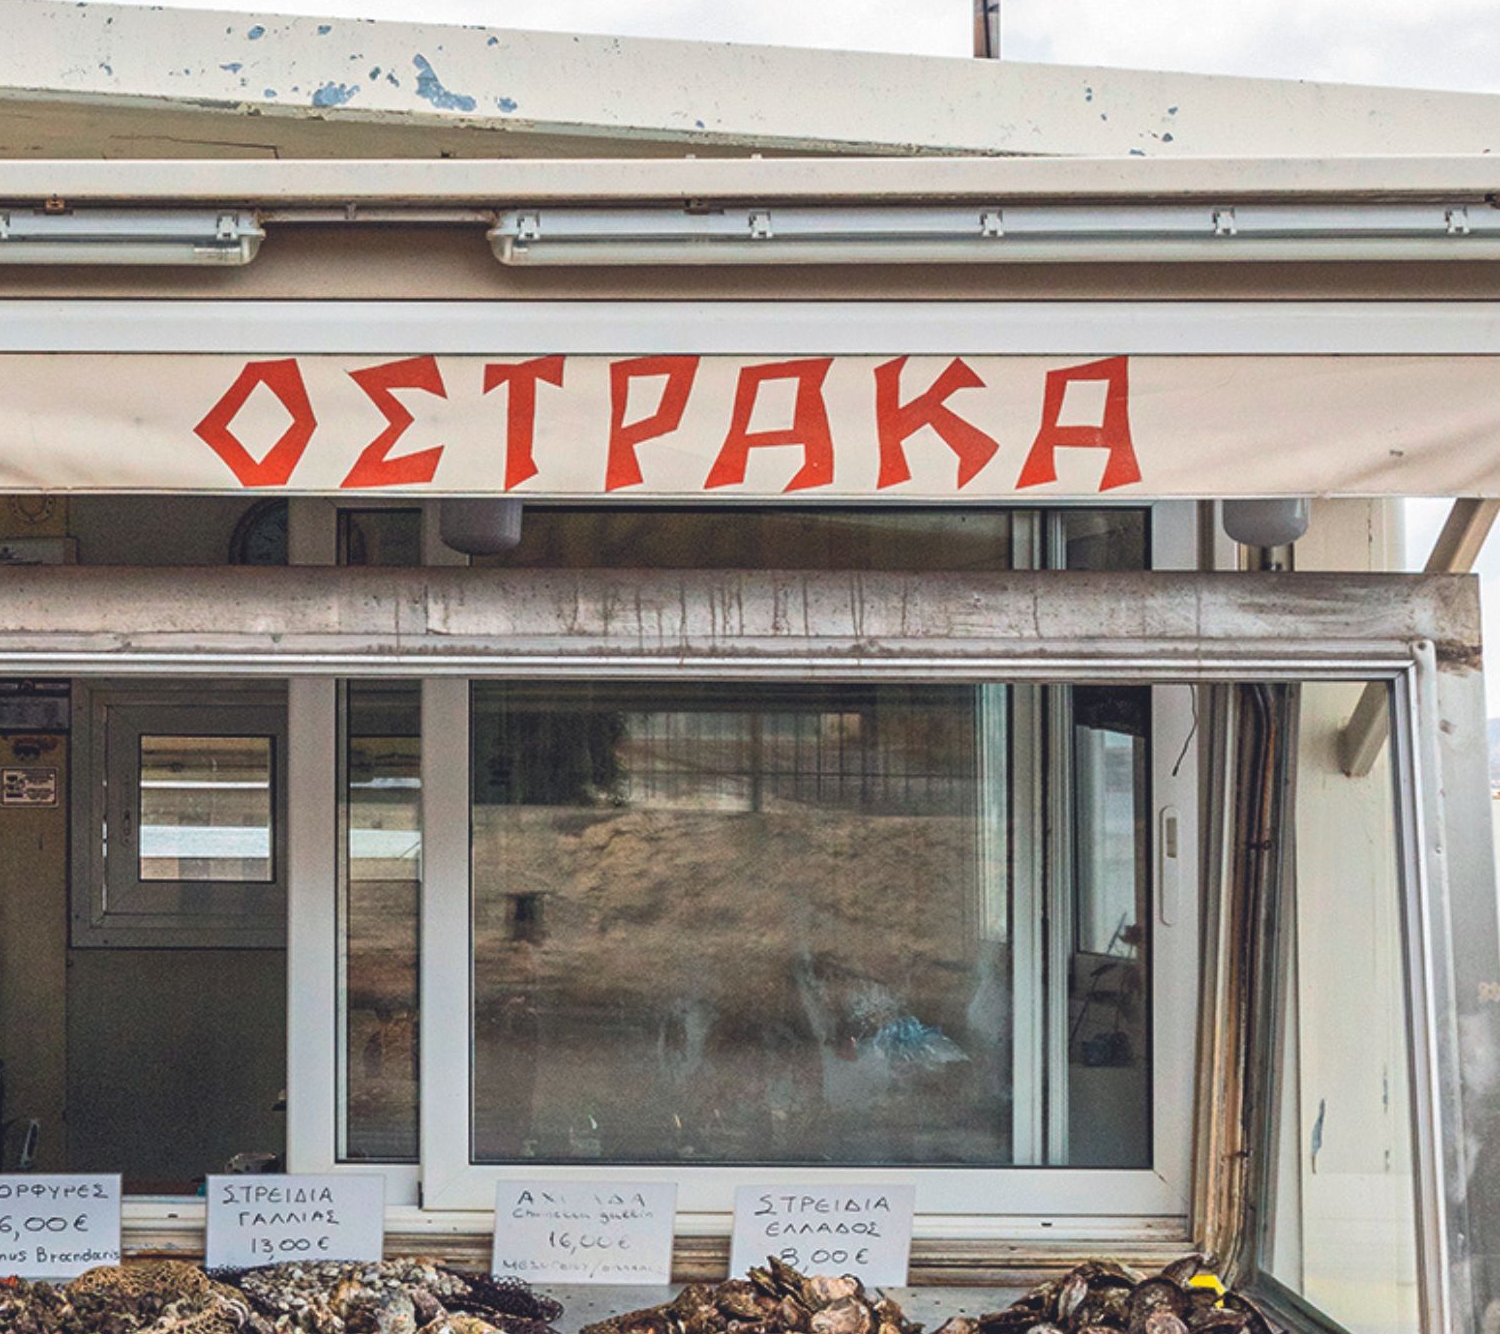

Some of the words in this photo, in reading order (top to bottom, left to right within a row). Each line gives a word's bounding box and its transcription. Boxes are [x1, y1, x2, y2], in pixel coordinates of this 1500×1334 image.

[193, 354, 1143, 493] ΟΣΤΡΑΚΑ
[222, 1184, 333, 1205] ΣΤΡΕΙΔΙΑ
[753, 1194, 891, 1216] ΣΤΡΕΙΔΙΑ
[239, 1209, 340, 1226] ΓΑΛΛΙΑΣ
[765, 1221, 882, 1238] ΕΛΛΑΔΟΣ
